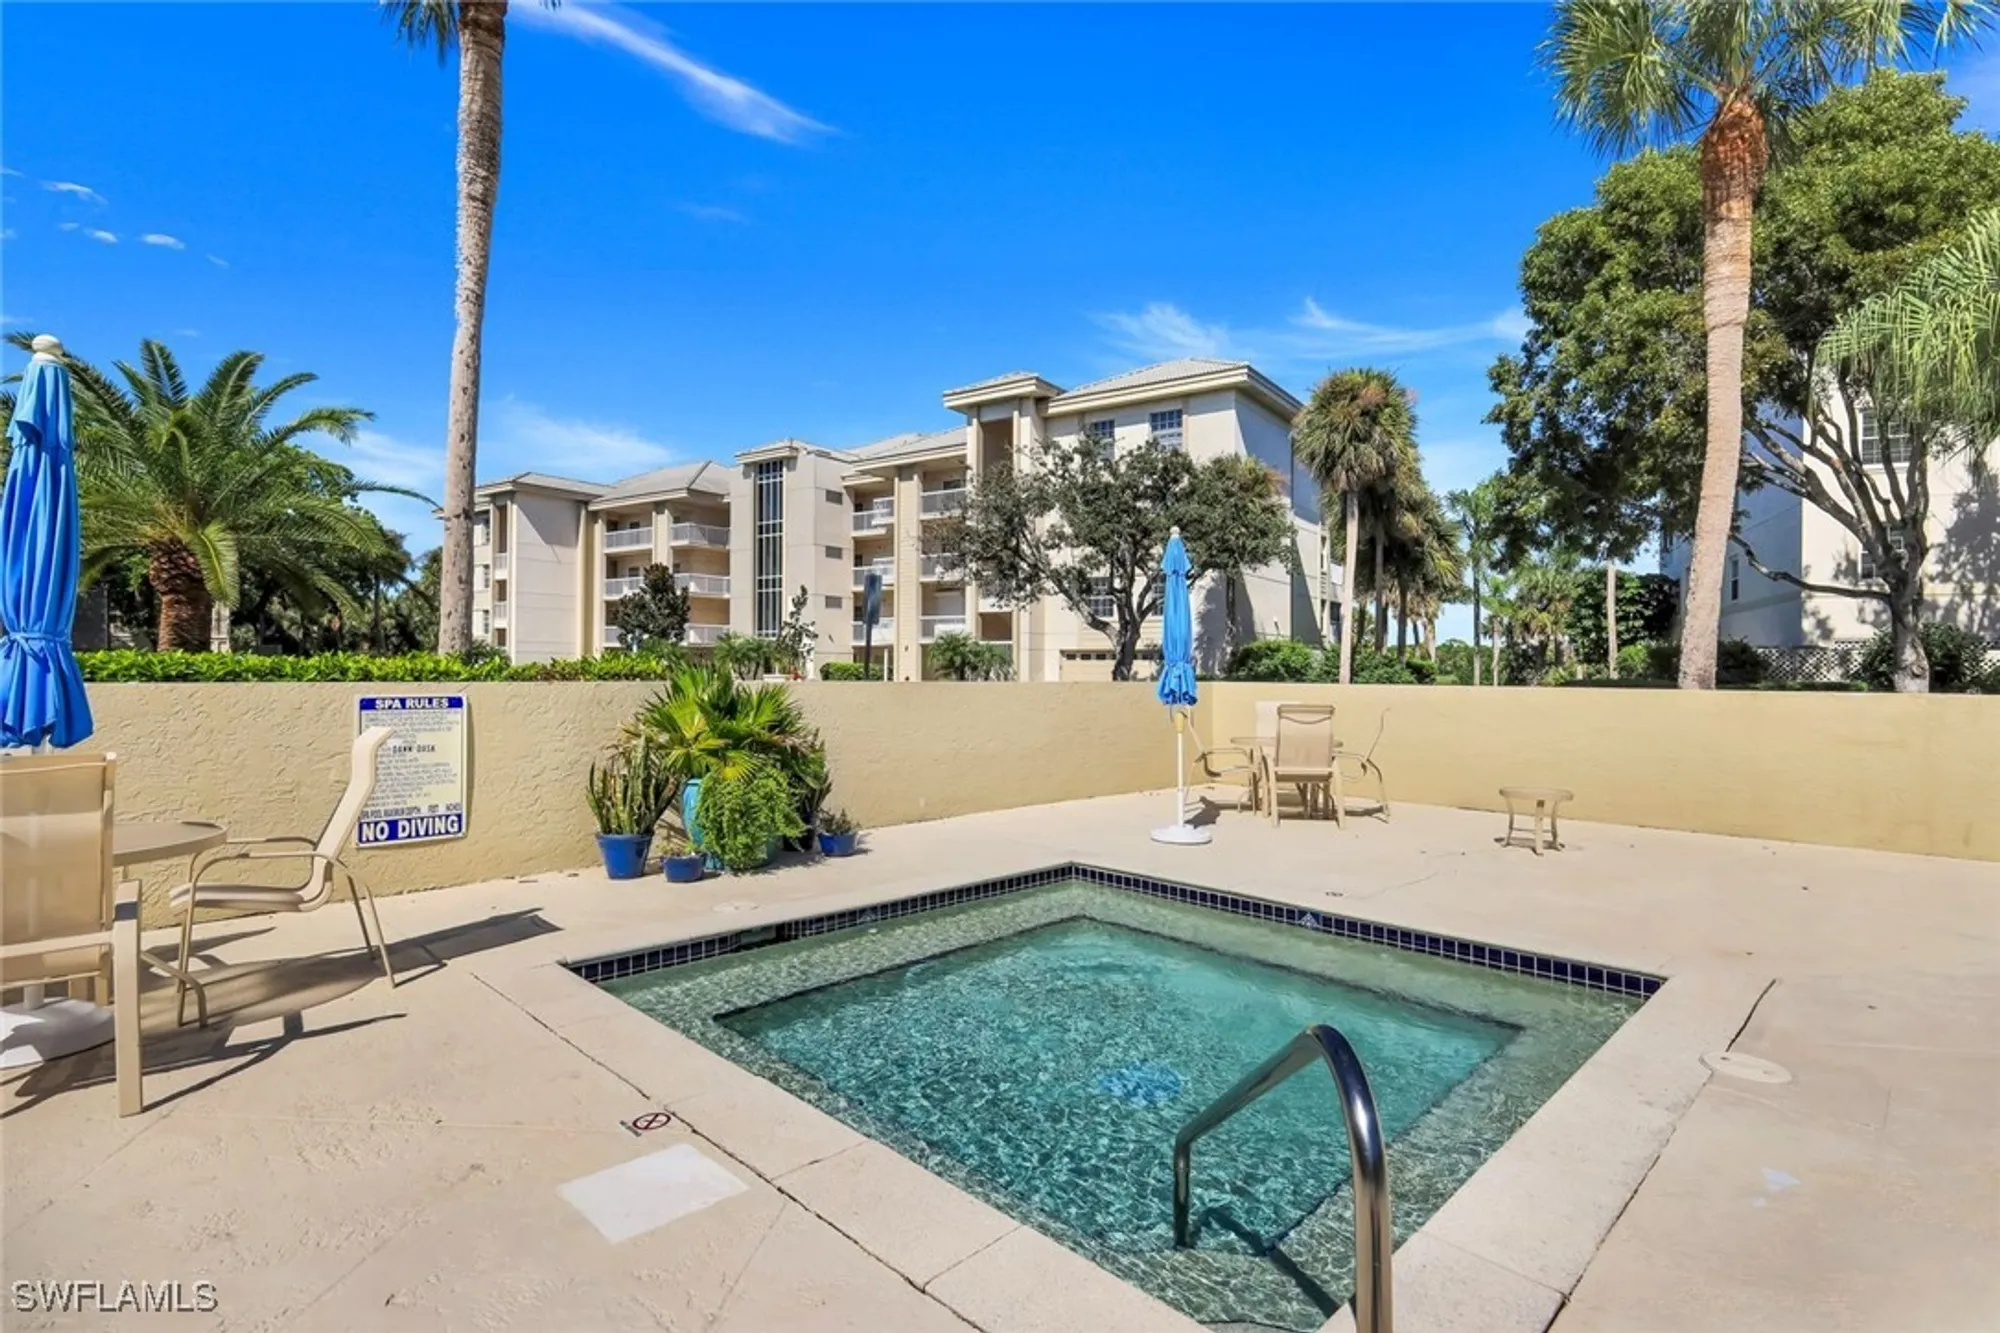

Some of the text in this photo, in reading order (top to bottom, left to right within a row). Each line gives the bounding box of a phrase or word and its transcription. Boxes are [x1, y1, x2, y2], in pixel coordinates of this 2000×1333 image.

[375, 698, 449, 709] SPA RULES
[361, 815, 459, 841] NO DIVING
